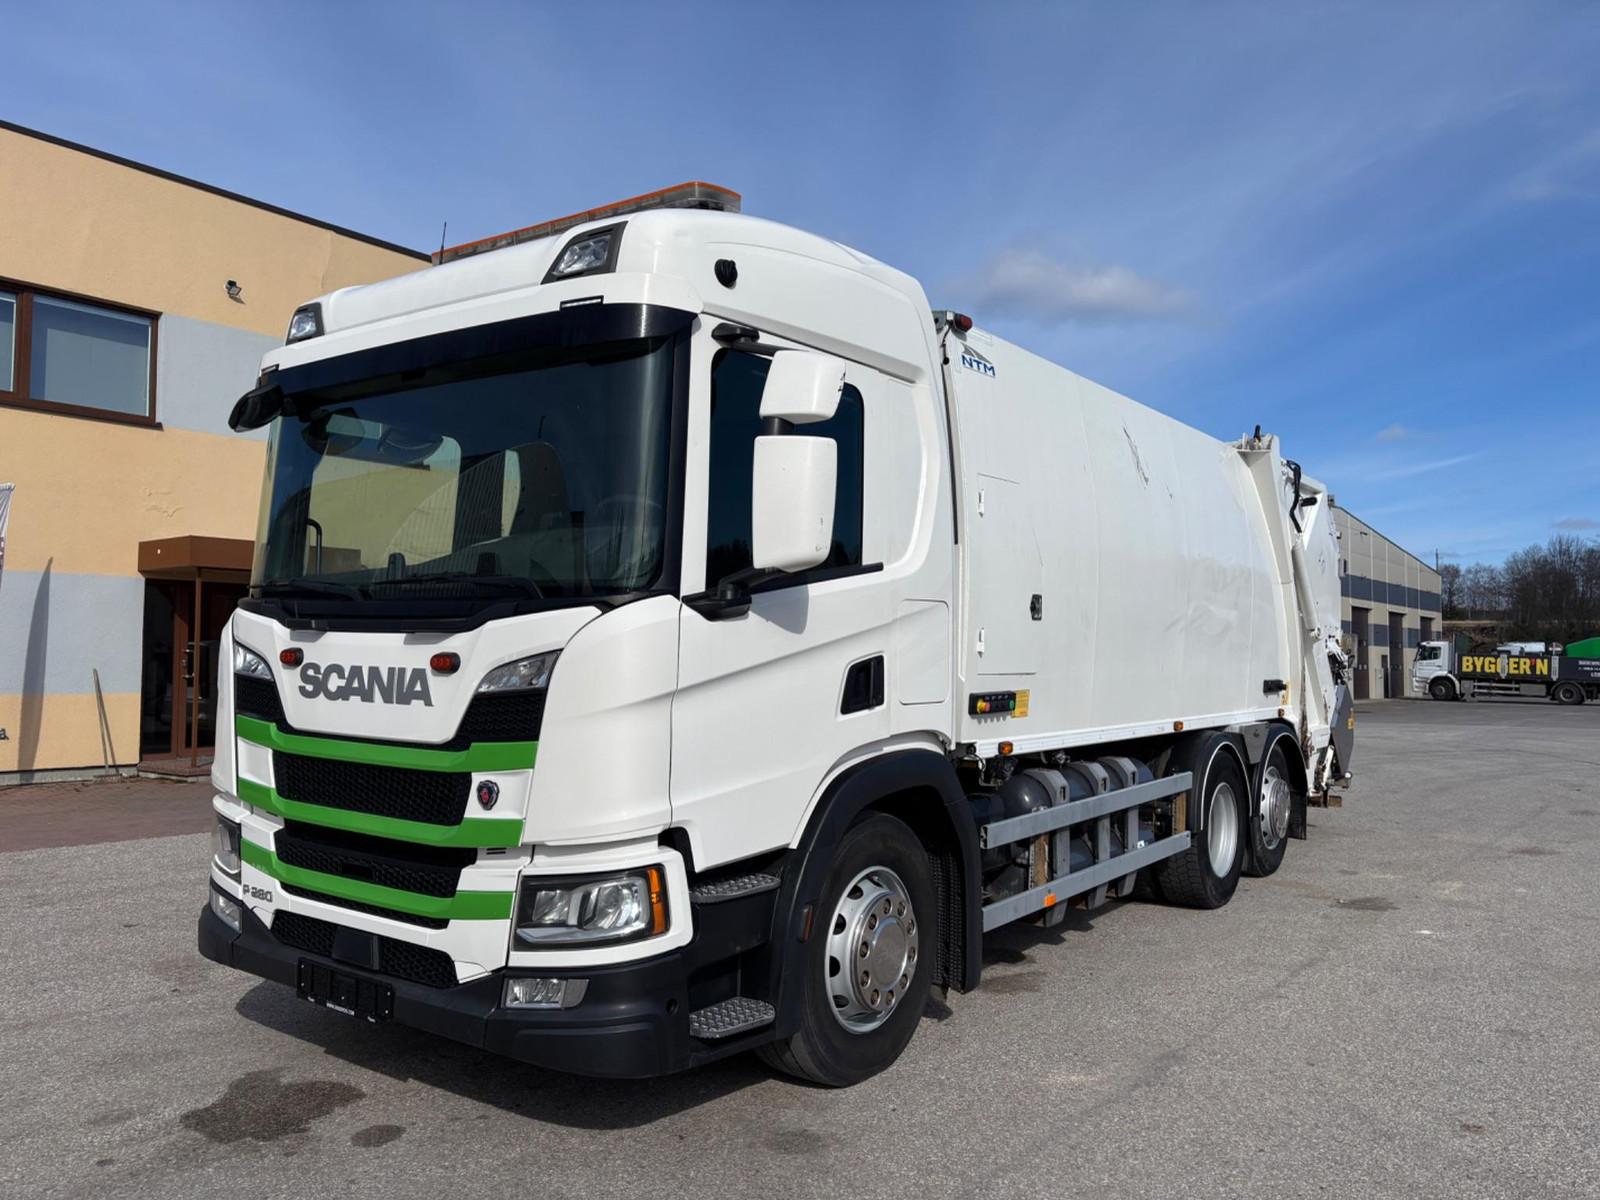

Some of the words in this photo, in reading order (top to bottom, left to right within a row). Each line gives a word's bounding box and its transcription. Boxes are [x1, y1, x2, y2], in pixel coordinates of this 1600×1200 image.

[961, 354, 996, 377] NTM
[1461, 655, 1548, 675] BYGER'N
[298, 662, 434, 707] SCANIA
